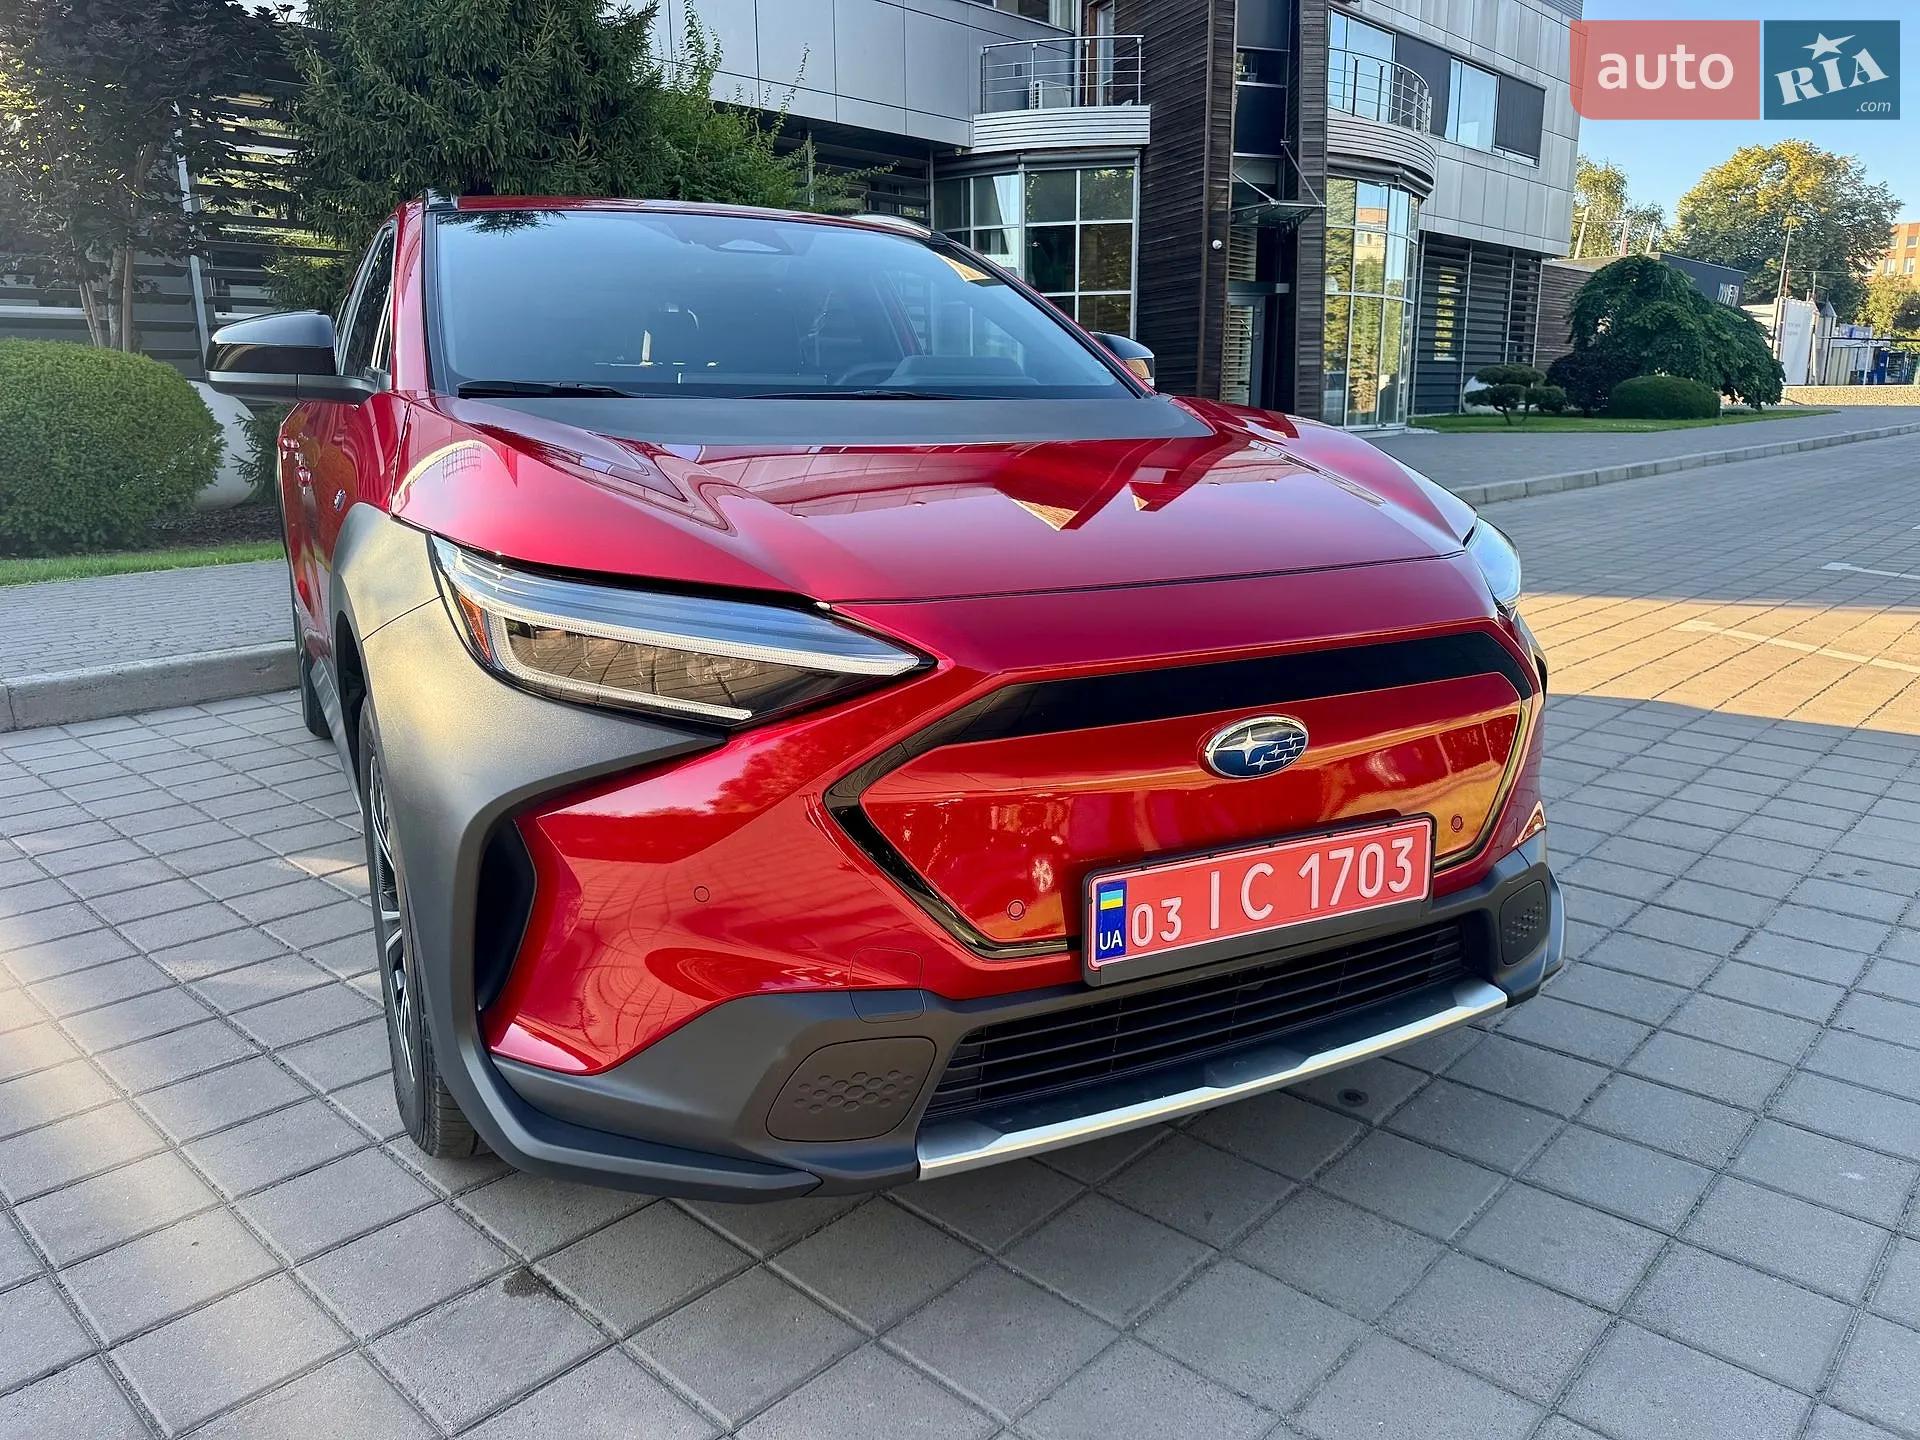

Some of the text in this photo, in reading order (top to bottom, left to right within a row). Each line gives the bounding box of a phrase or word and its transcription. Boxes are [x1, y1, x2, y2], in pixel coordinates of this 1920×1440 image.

[1131, 896, 1183, 947] 03
[1298, 836, 1414, 910] 1703
[1099, 929, 1123, 951] UA
